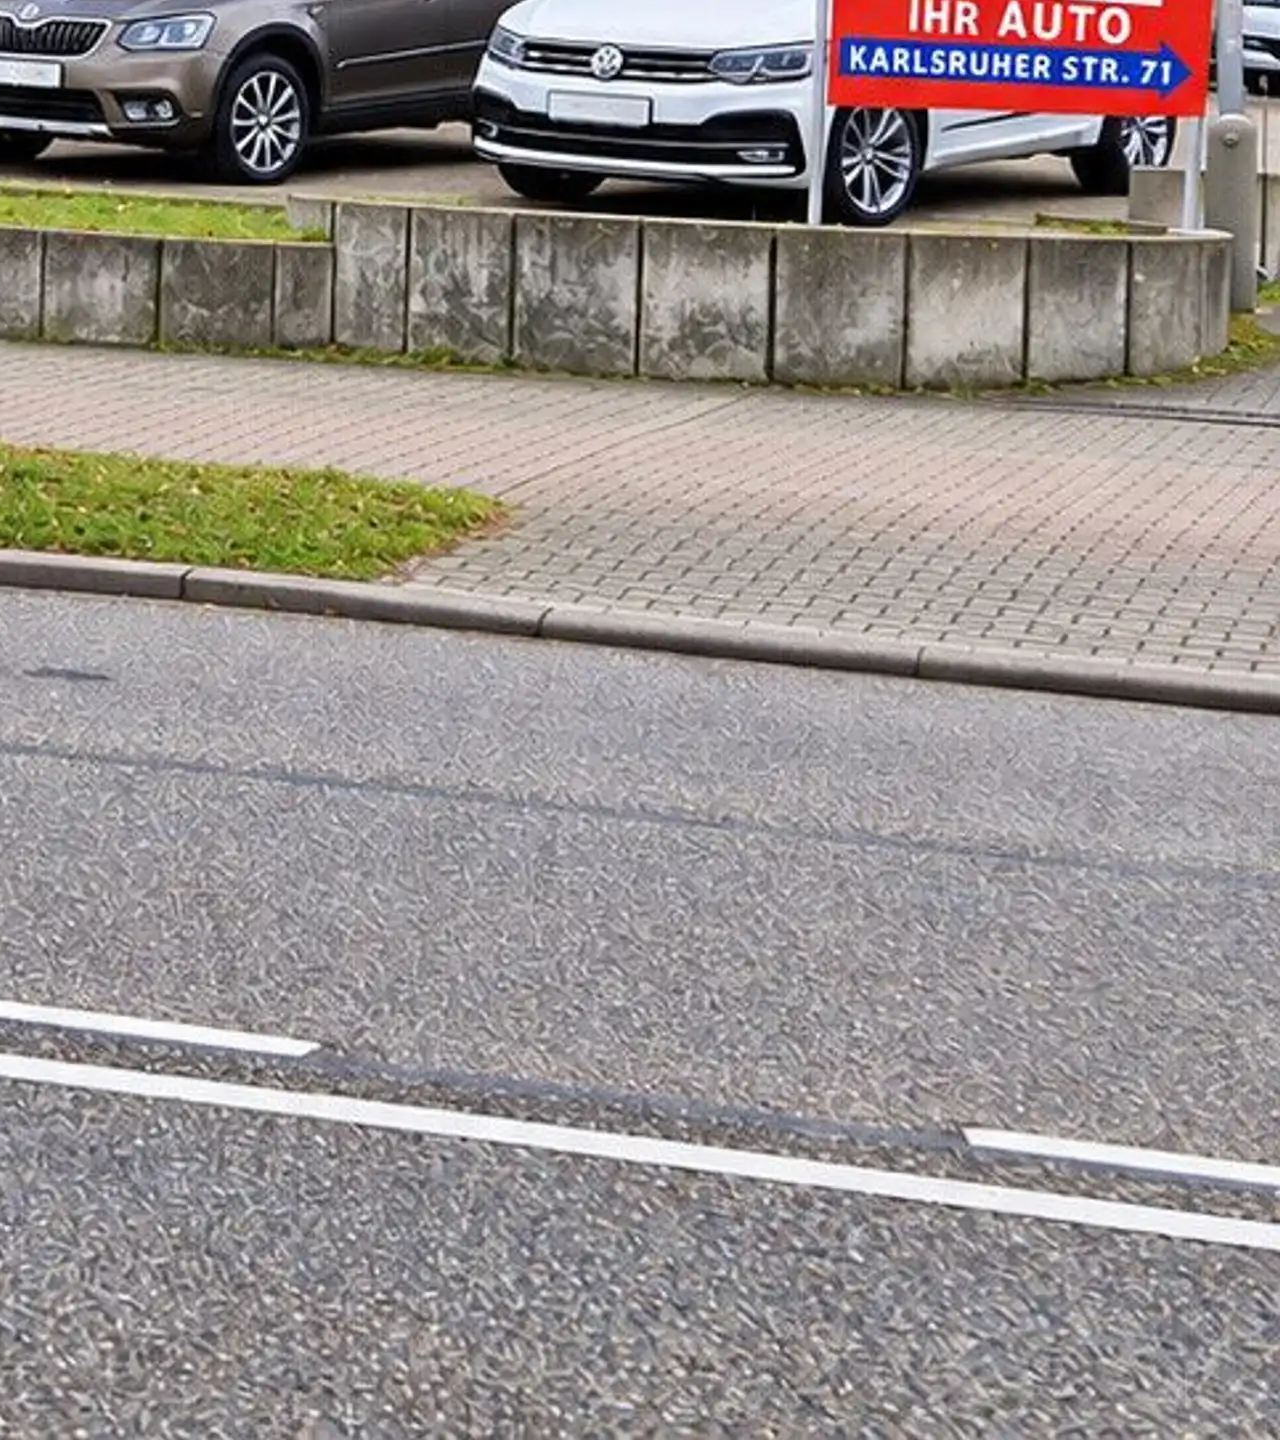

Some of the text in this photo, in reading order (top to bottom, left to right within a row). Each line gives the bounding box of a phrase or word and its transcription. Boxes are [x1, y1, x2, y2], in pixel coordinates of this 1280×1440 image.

[850, 45, 1172, 85] KARLSRUHER STR. 71
